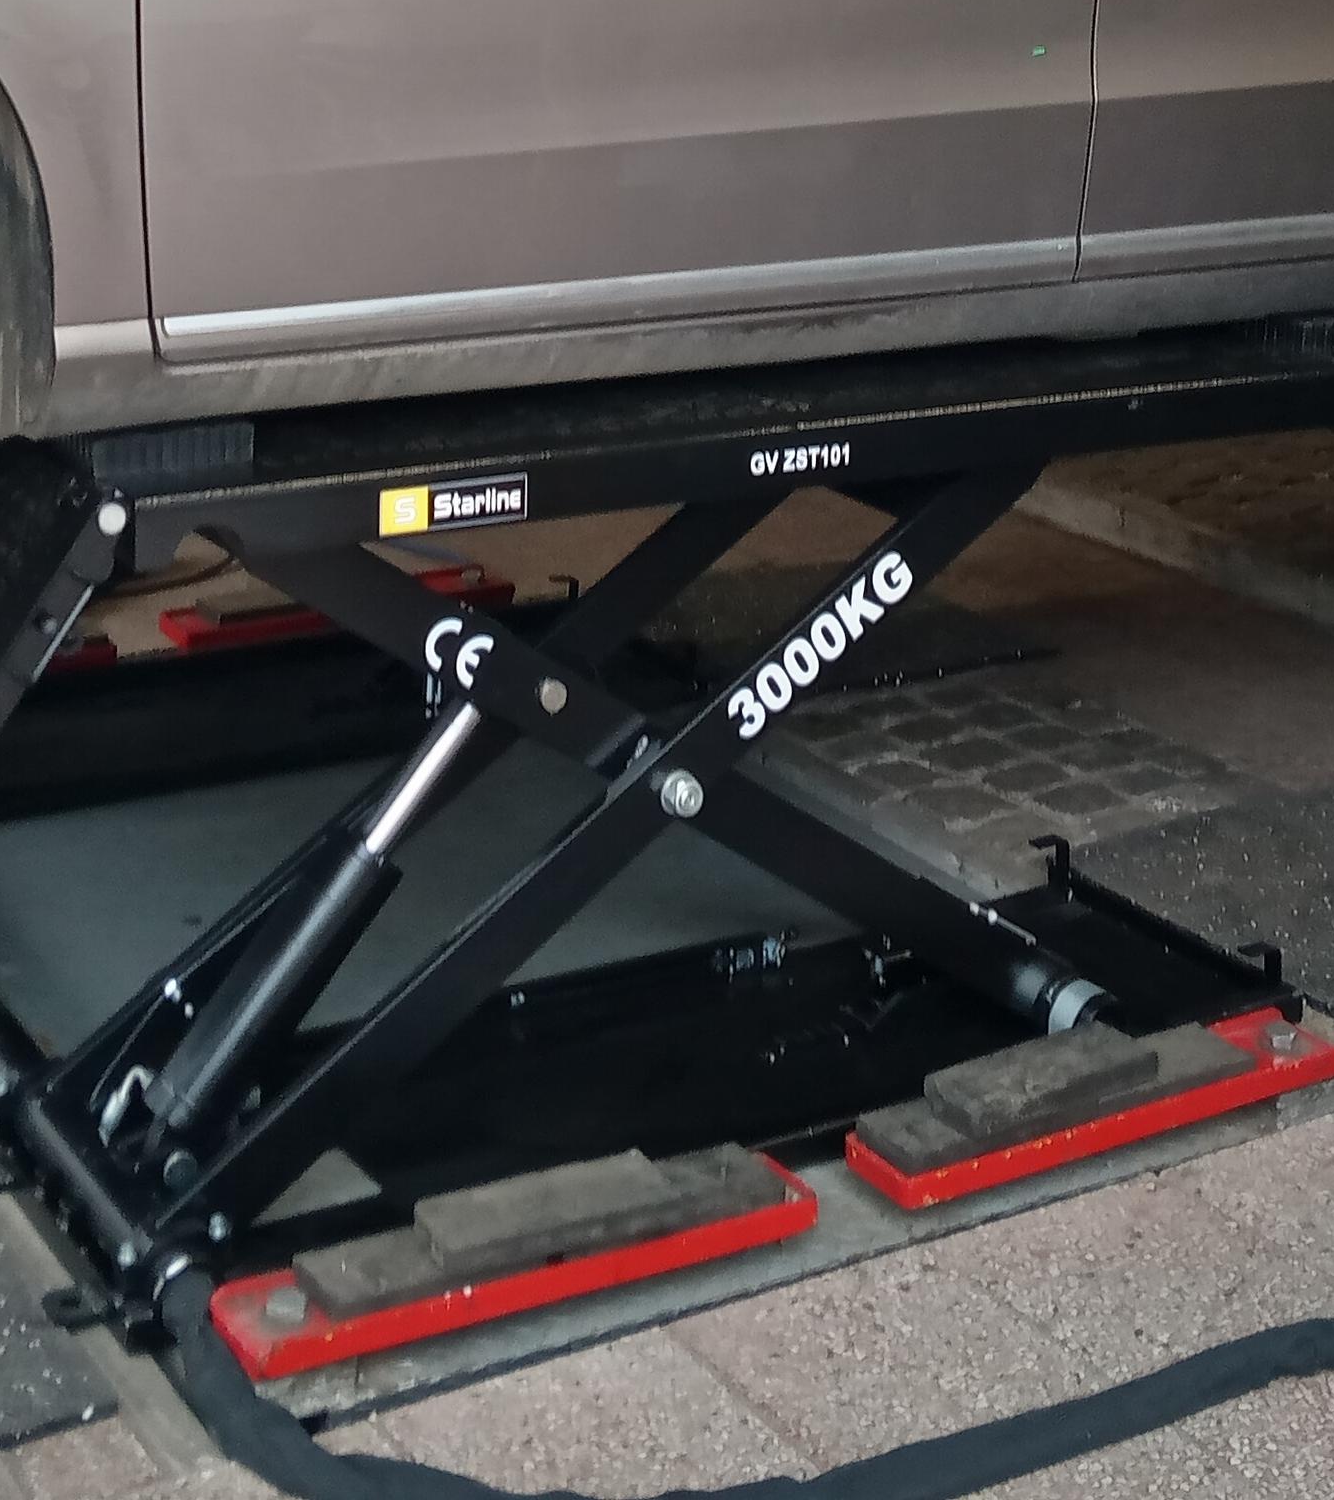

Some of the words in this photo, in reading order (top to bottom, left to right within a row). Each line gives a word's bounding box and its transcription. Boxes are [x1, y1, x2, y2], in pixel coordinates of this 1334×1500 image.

[750, 449, 779, 476] GV
[783, 441, 850, 473] ZST101
[433, 487, 521, 520] Starline
[425, 617, 494, 690] CE
[728, 551, 913, 739] 3000KG
